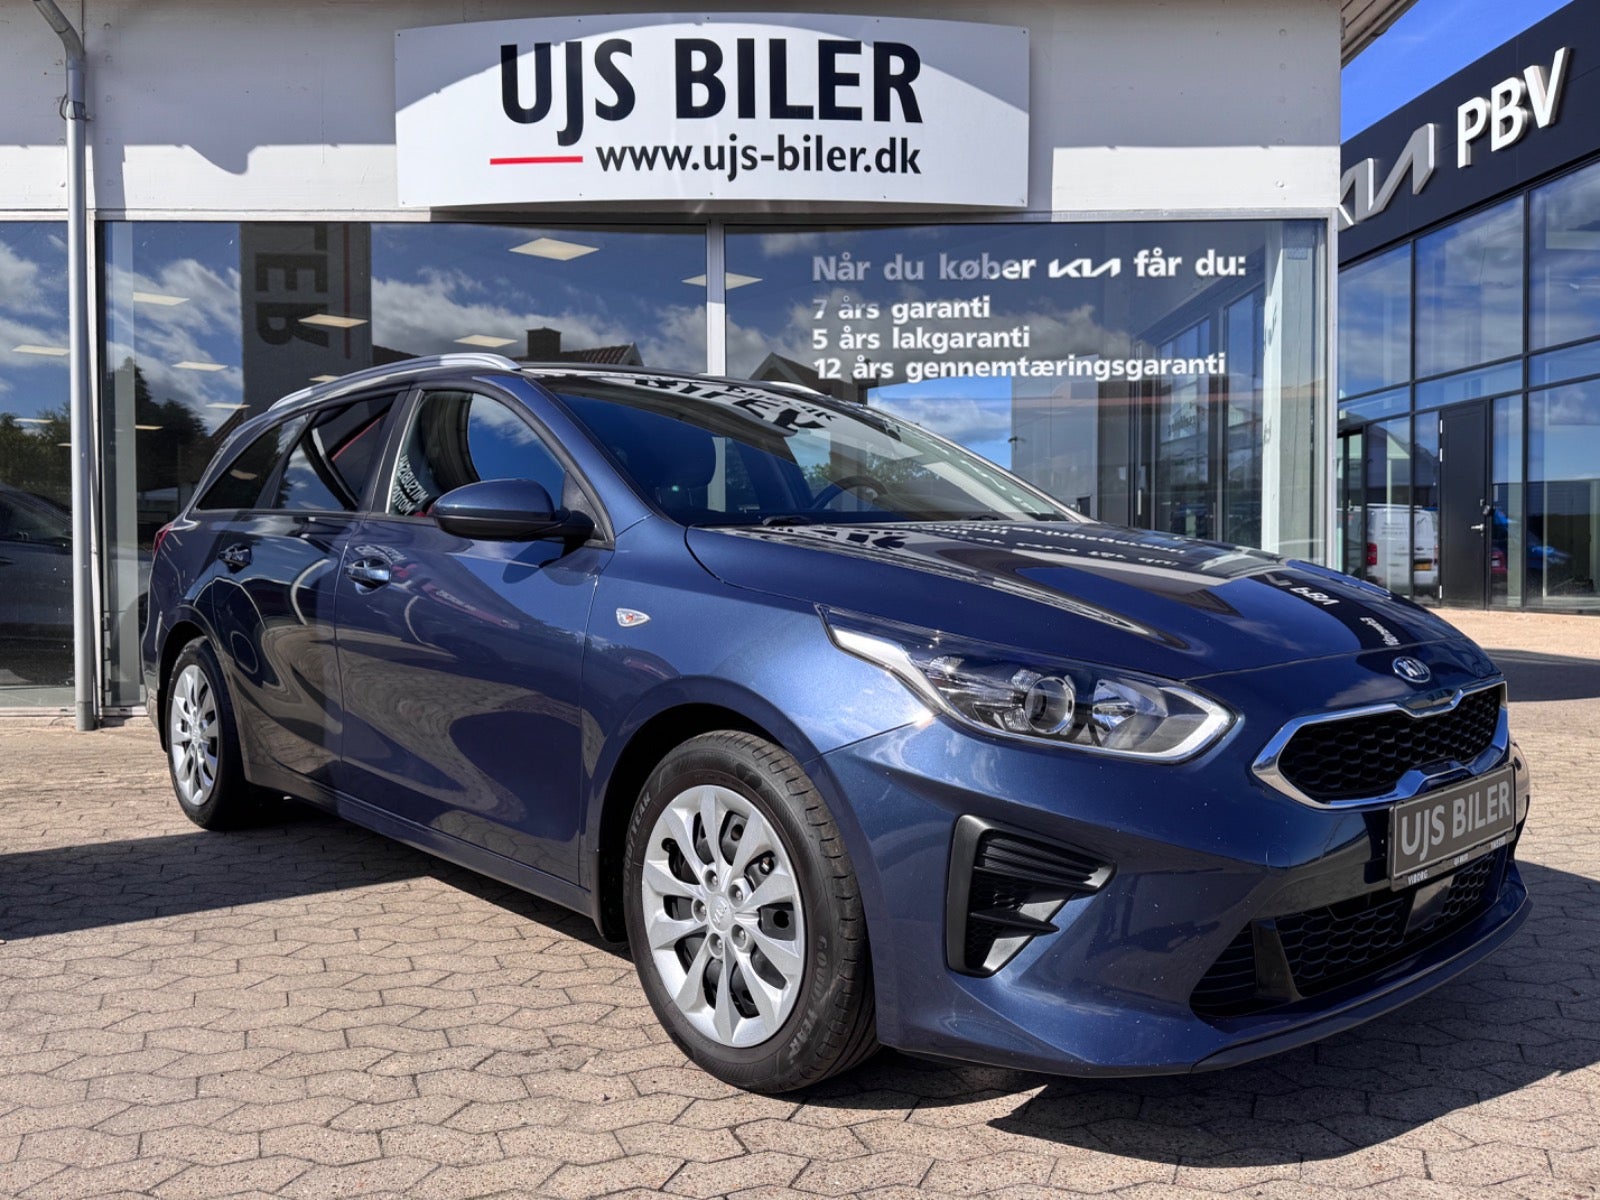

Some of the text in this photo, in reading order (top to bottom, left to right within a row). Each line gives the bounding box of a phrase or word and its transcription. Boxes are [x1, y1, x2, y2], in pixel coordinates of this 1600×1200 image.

[500, 37, 923, 146] UJS BILER
[1457, 47, 1570, 168] PBV
[595, 133, 922, 182] www.ujs-biler.dk
[812, 247, 1246, 281] Når du køber KIA får du:
[812, 295, 990, 324] 7 års garanti
[812, 325, 1030, 354] 5 års lakgaranti
[813, 353, 1226, 383] 12 års gennemtæringsgaranti
[1401, 780, 1511, 862] UJS BILER
